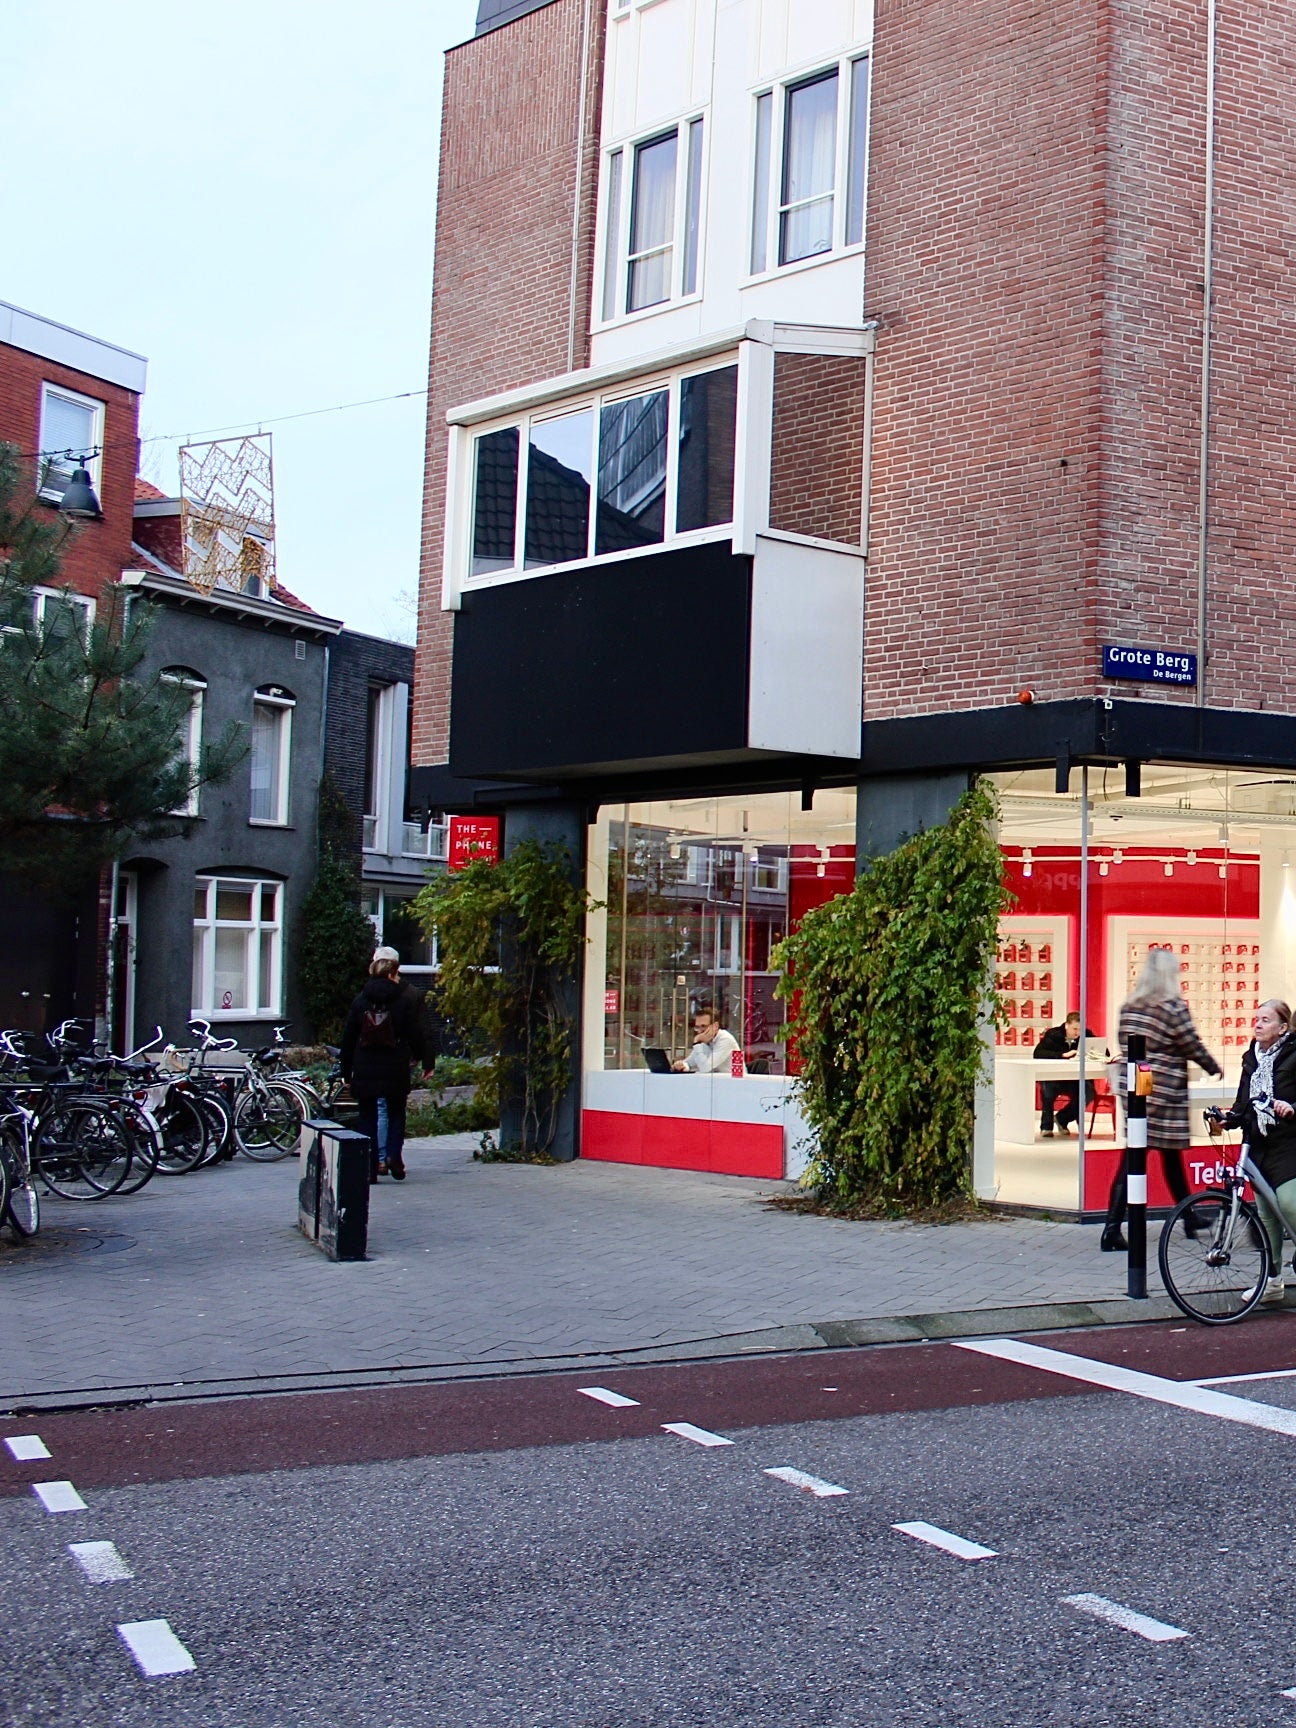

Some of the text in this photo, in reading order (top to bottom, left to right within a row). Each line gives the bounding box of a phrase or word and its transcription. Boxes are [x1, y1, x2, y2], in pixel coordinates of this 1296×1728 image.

[1109, 647, 1190, 672] Grote Berg
[1153, 669, 1192, 682] De Bergen
[456, 824, 477, 834] THE
